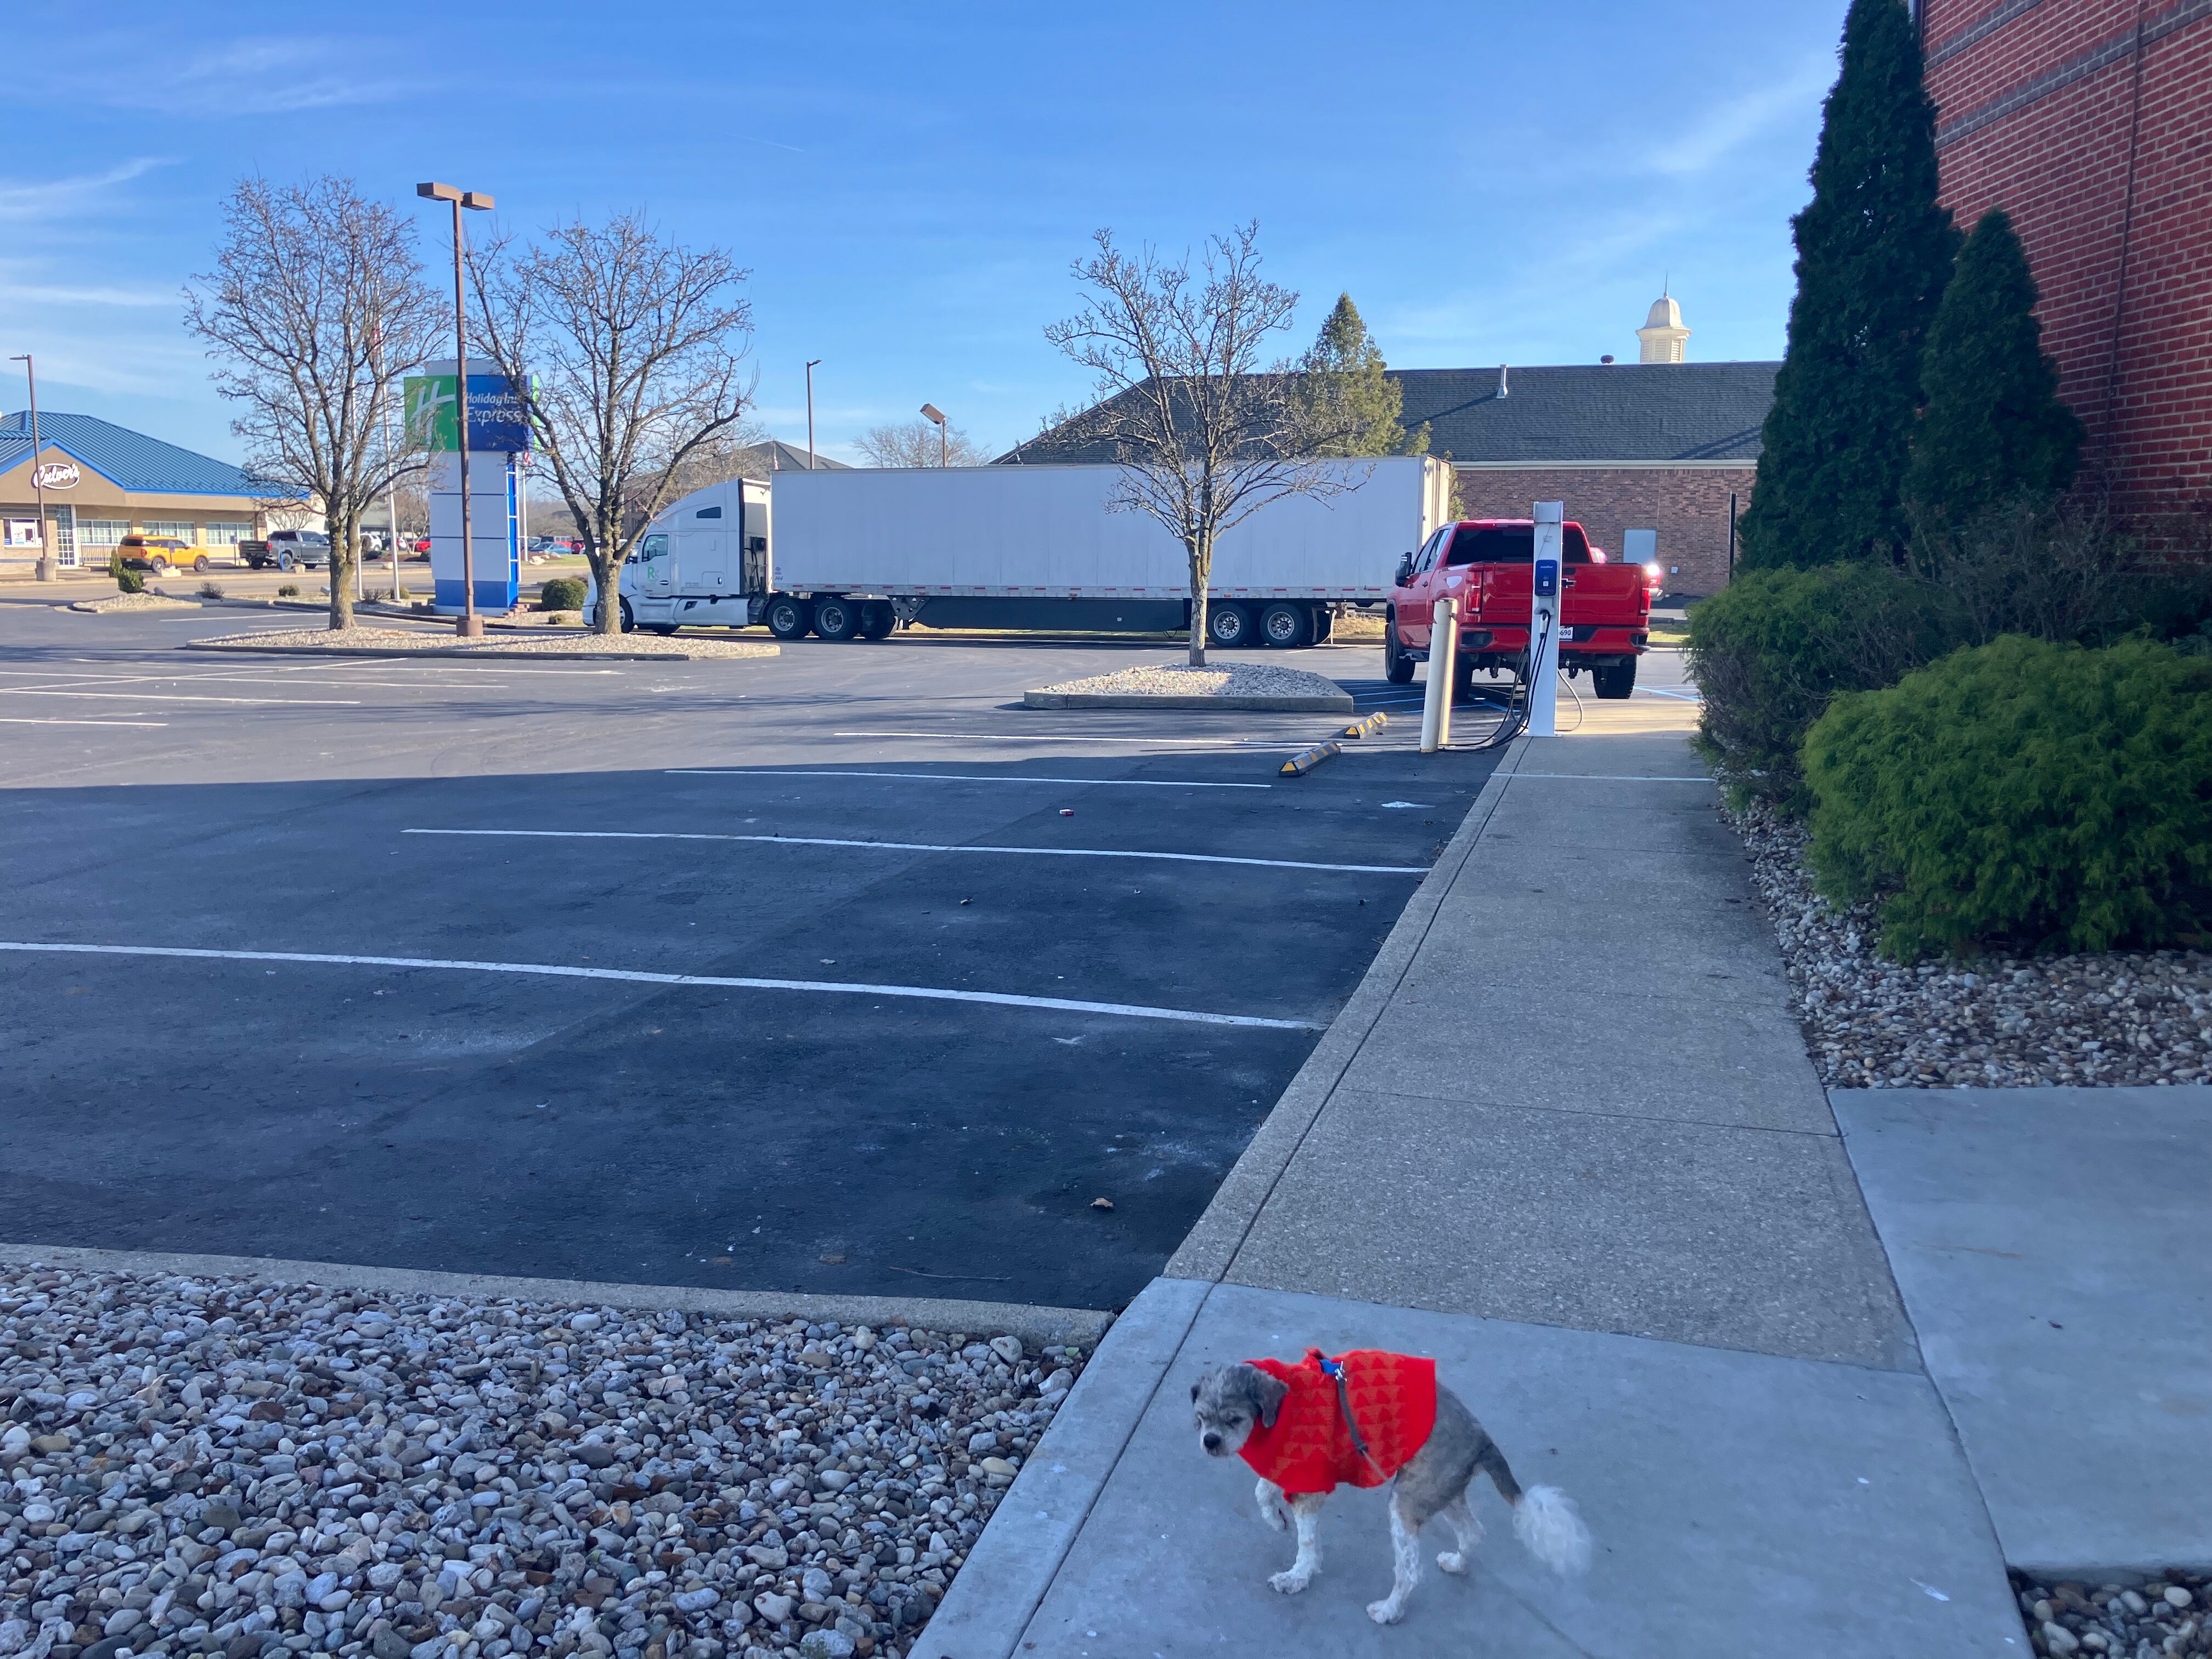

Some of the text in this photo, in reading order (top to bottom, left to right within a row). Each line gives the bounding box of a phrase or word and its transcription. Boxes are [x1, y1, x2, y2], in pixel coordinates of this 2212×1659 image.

[467, 392, 503, 406] Holiday
[467, 407, 523, 426] Express
[33, 463, 80, 488] Culver's
